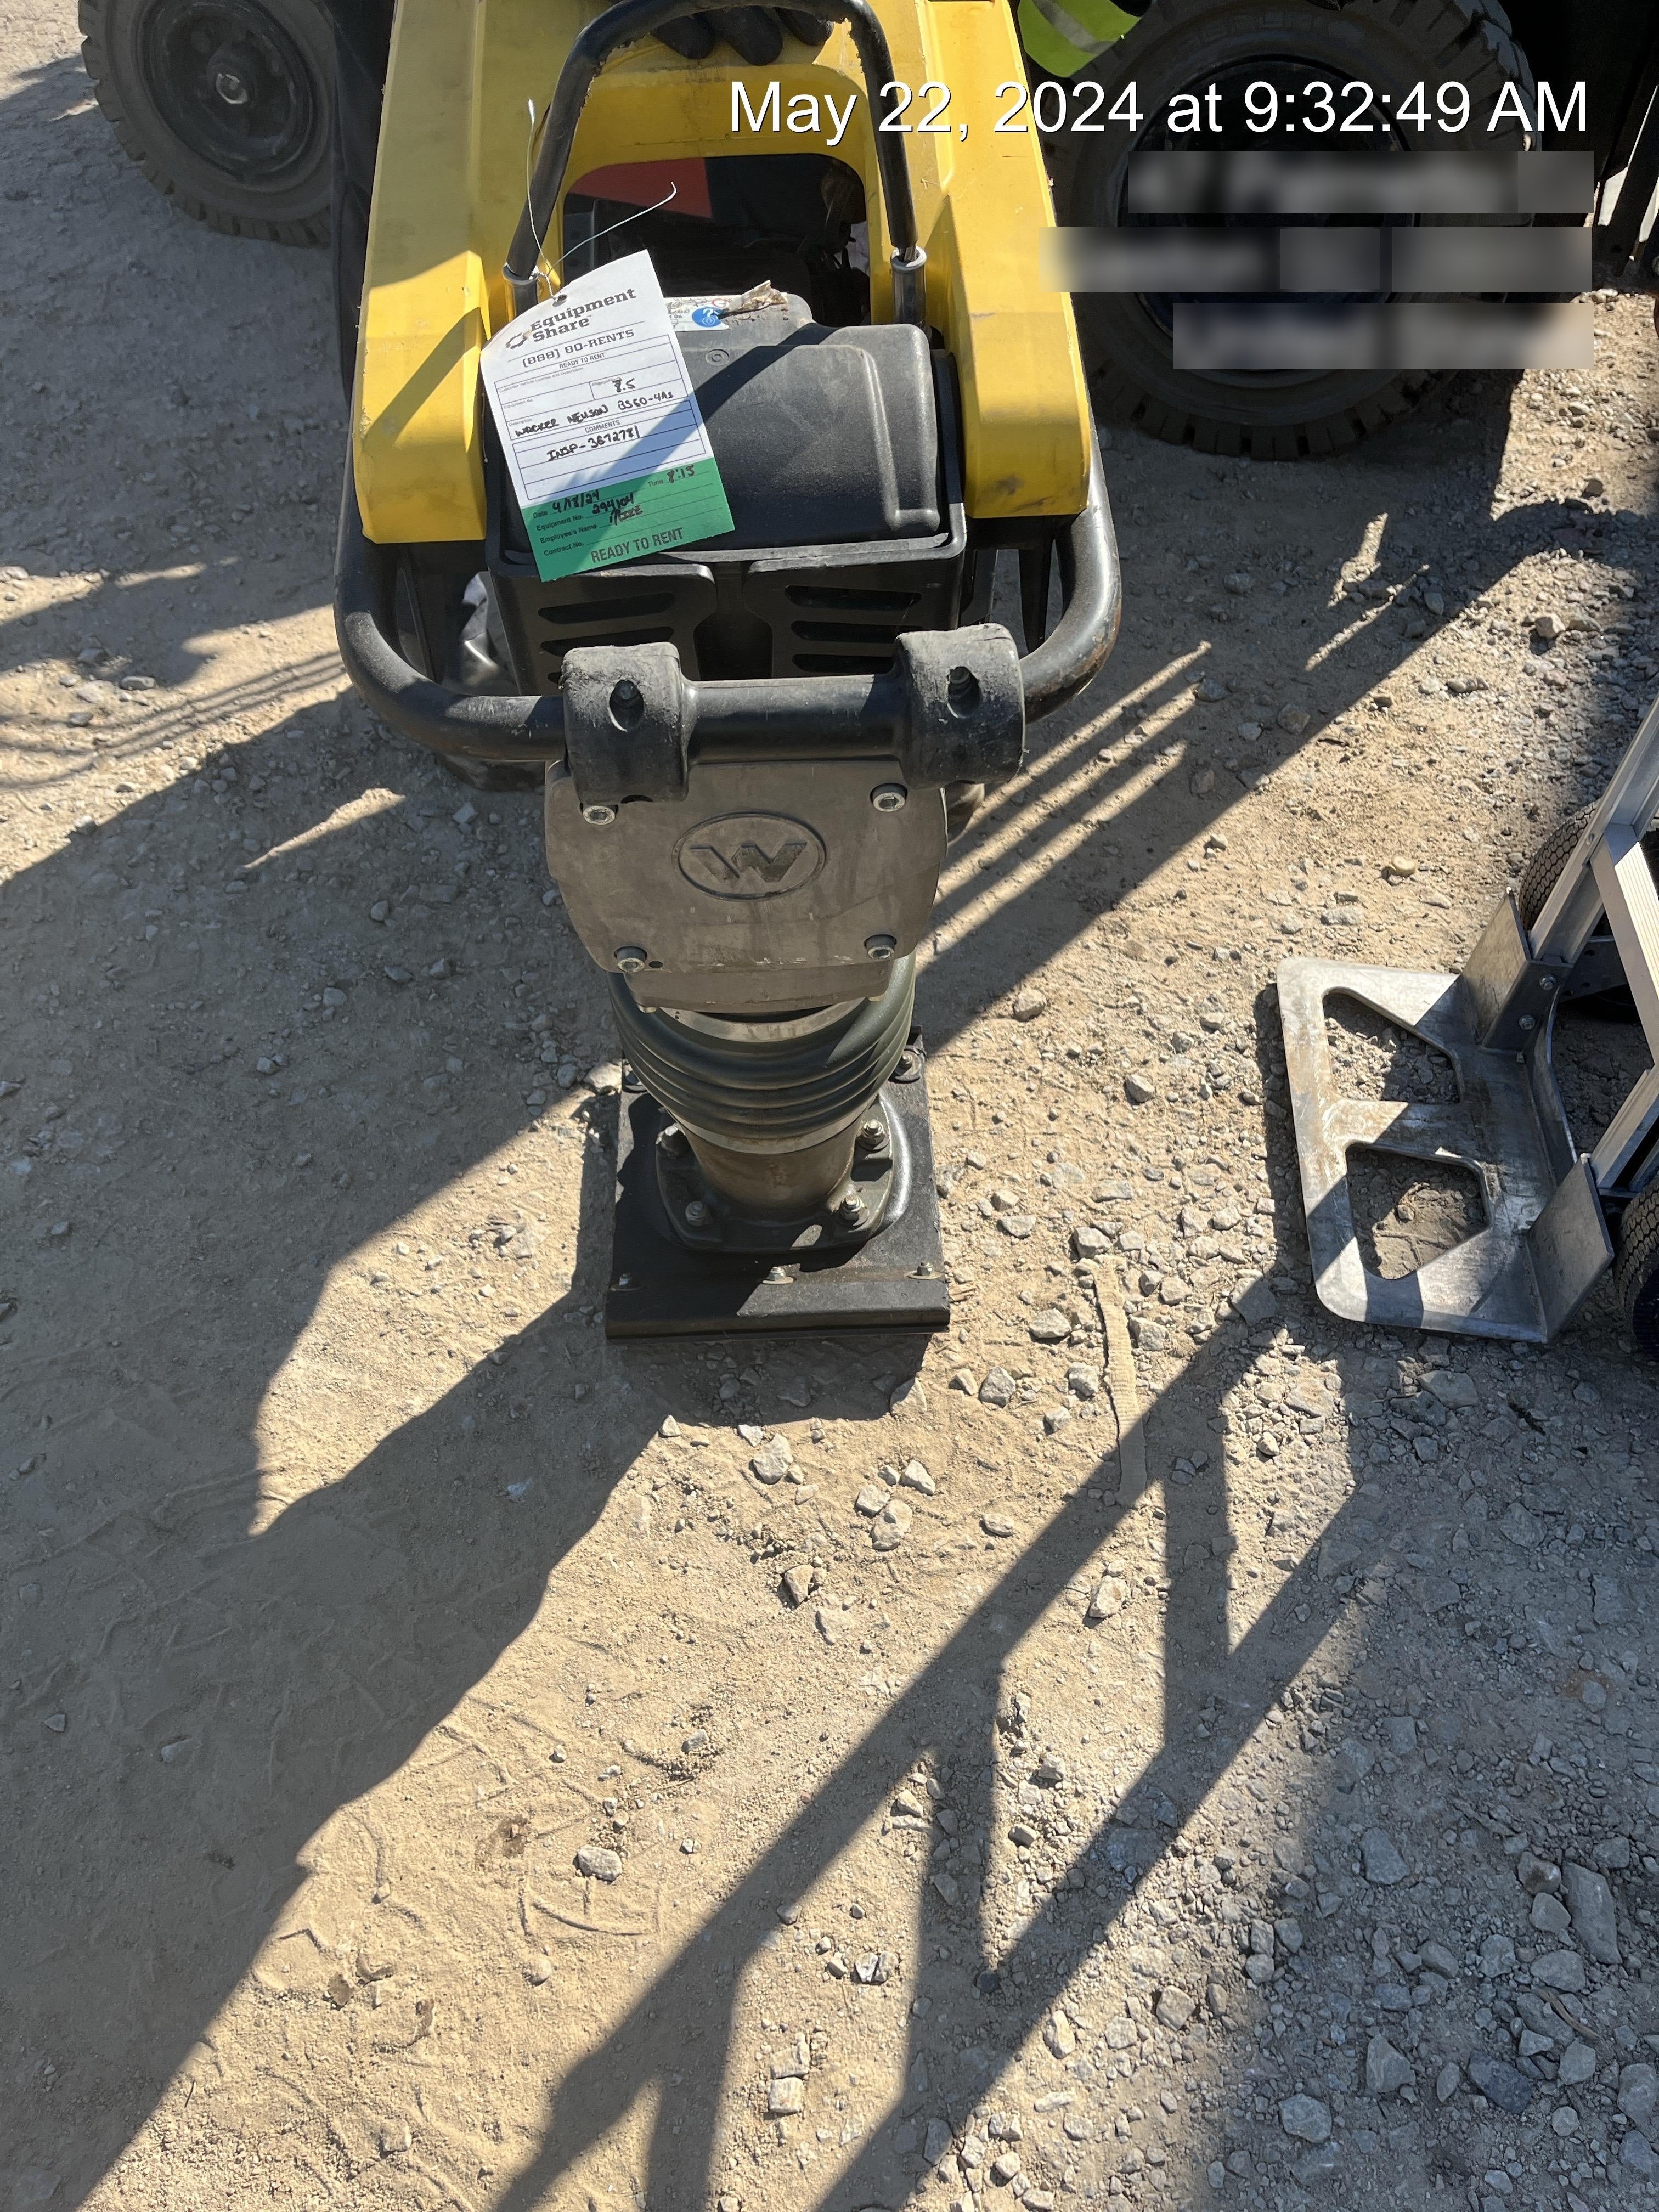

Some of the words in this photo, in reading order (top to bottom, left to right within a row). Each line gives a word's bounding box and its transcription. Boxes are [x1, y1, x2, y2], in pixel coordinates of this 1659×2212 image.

[530, 289, 637, 331] Equipment
[532, 318, 590, 342] Share
[522, 349, 560, 368] (888)
[564, 329, 635, 354] 80-RENTS
[559, 359, 579, 369] READY
[590, 353, 606, 362] RENT
[509, 418, 532, 426] Description
[585, 420, 620, 433] COMMENTS
[648, 479, 663, 487] Time
[533, 510, 548, 518] Date
[537, 517, 572, 531] Equipment
[540, 529, 577, 544] Employee's
[579, 524, 597, 533] Name
[544, 544, 571, 556] Contract
[590, 541, 629, 563] READY
[633, 537, 649, 551] TO
[652, 527, 684, 546] RENT
